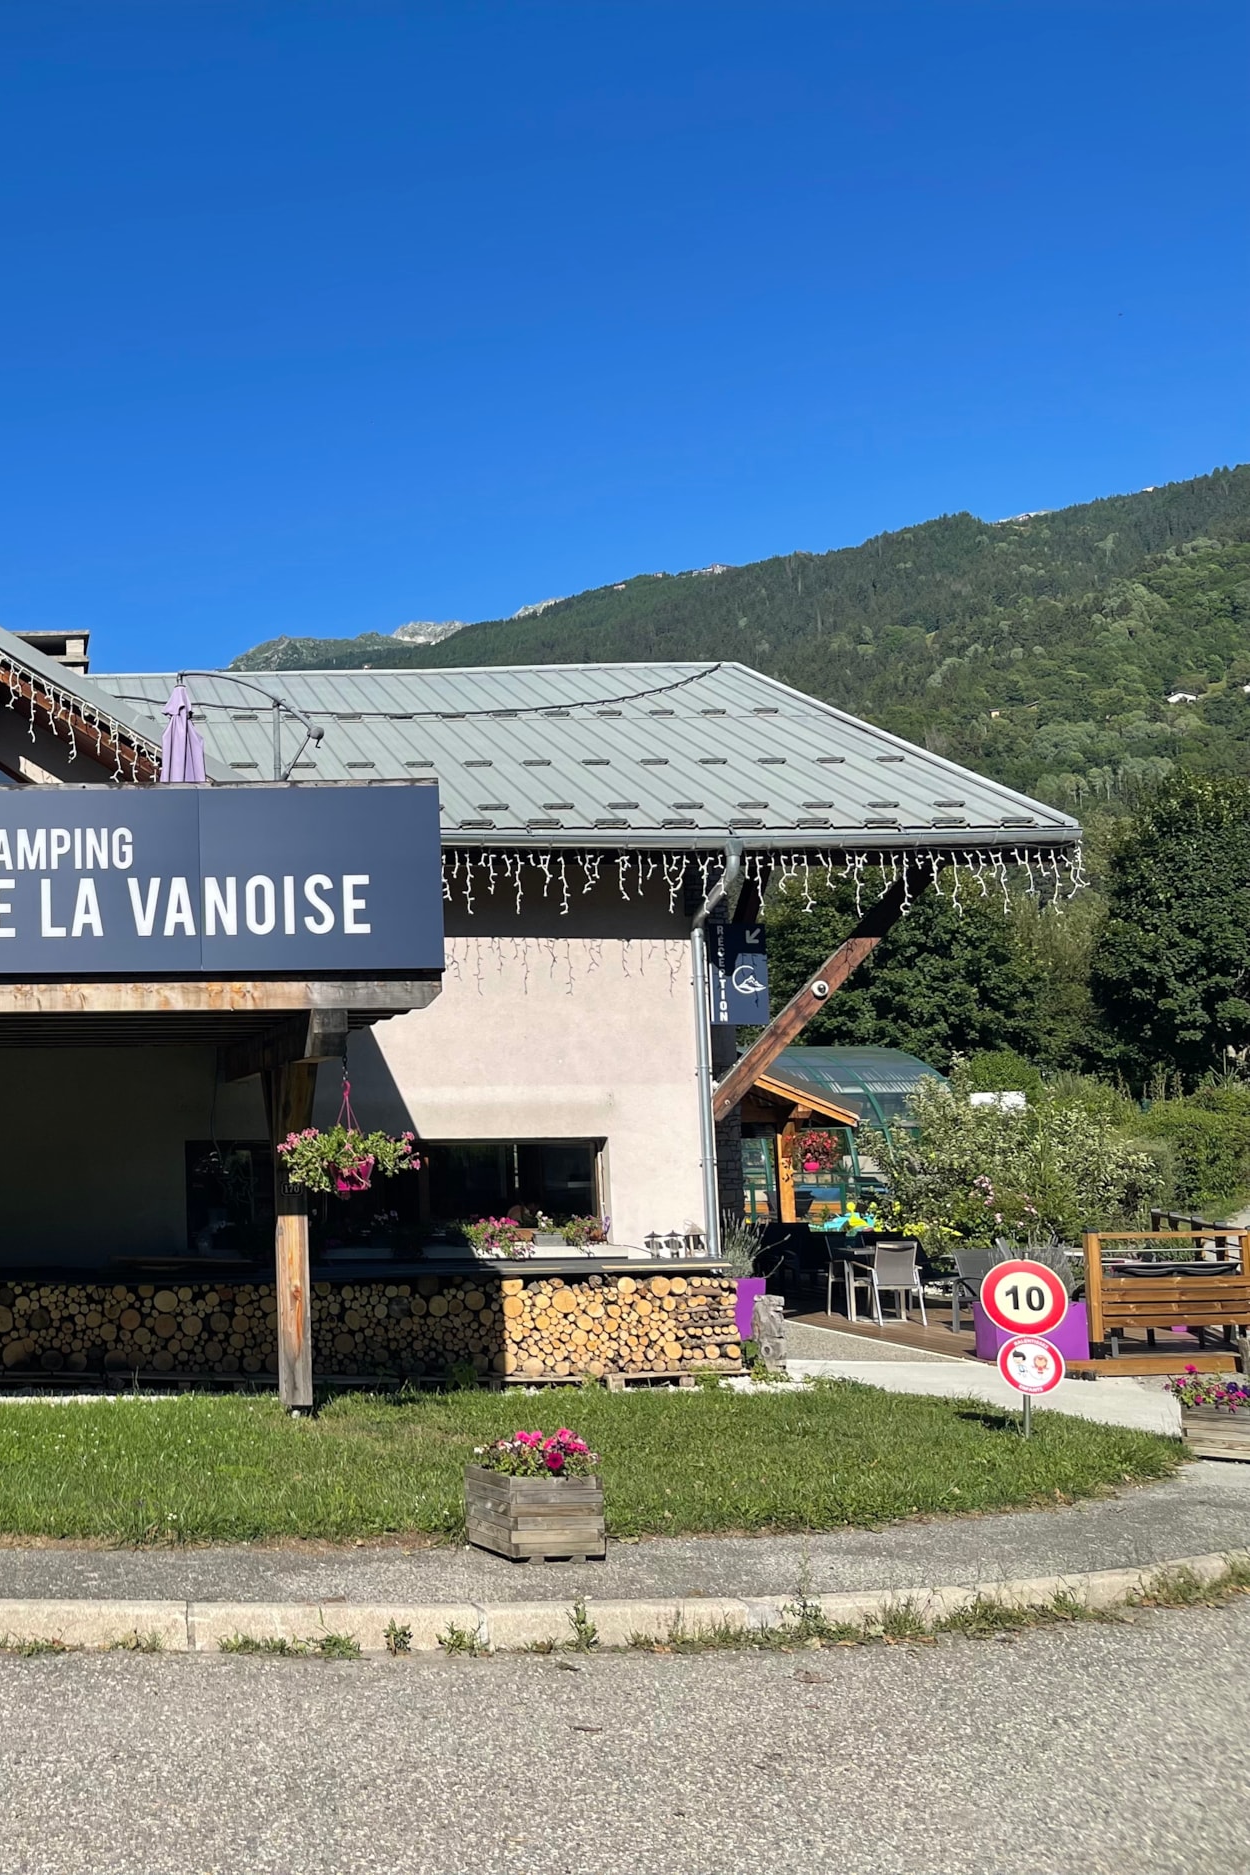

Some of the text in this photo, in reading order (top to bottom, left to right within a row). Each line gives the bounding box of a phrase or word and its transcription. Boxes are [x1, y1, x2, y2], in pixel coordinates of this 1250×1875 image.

[40, 877, 105, 938] LA
[126, 873, 372, 937] VANOISE
[716, 925, 729, 1022] RÉCEPTION
[284, 1184, 300, 1193] 170
[1005, 1285, 1045, 1311] 10
